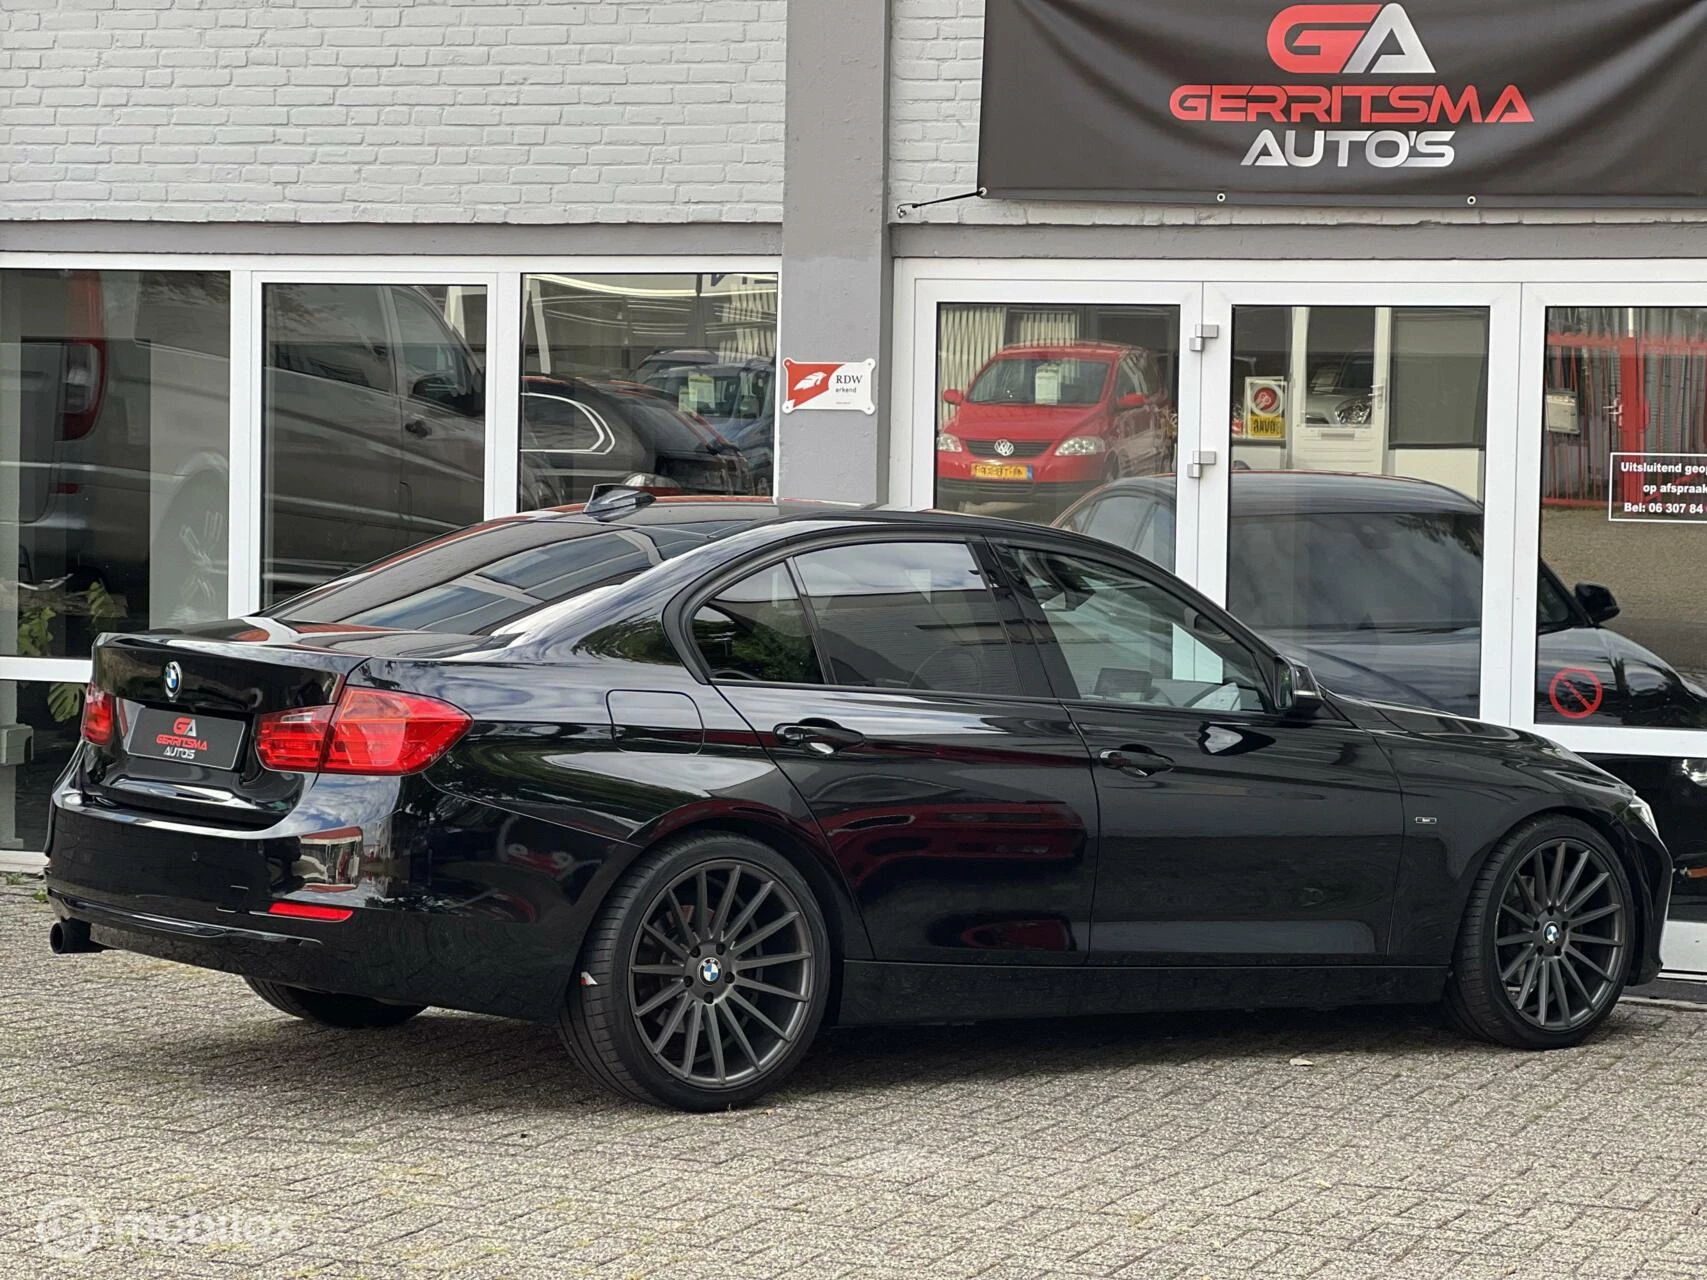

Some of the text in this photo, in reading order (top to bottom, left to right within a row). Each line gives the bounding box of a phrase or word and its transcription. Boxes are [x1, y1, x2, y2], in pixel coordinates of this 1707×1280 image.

[1266, 2, 1437, 74] GA
[1169, 84, 1535, 124] GERRITSMA
[1240, 128, 1456, 168] AUTO'S
[836, 375, 863, 384] RDW
[1621, 462, 1682, 472] Uitsluitend
[1643, 484, 1657, 495] op
[1624, 502, 1646, 512] Bel:
[1648, 502, 1663, 513] 06
[1665, 503, 1686, 513] 307
[1689, 503, 1703, 513] 84
[156, 734, 208, 751] GERRITSMA
